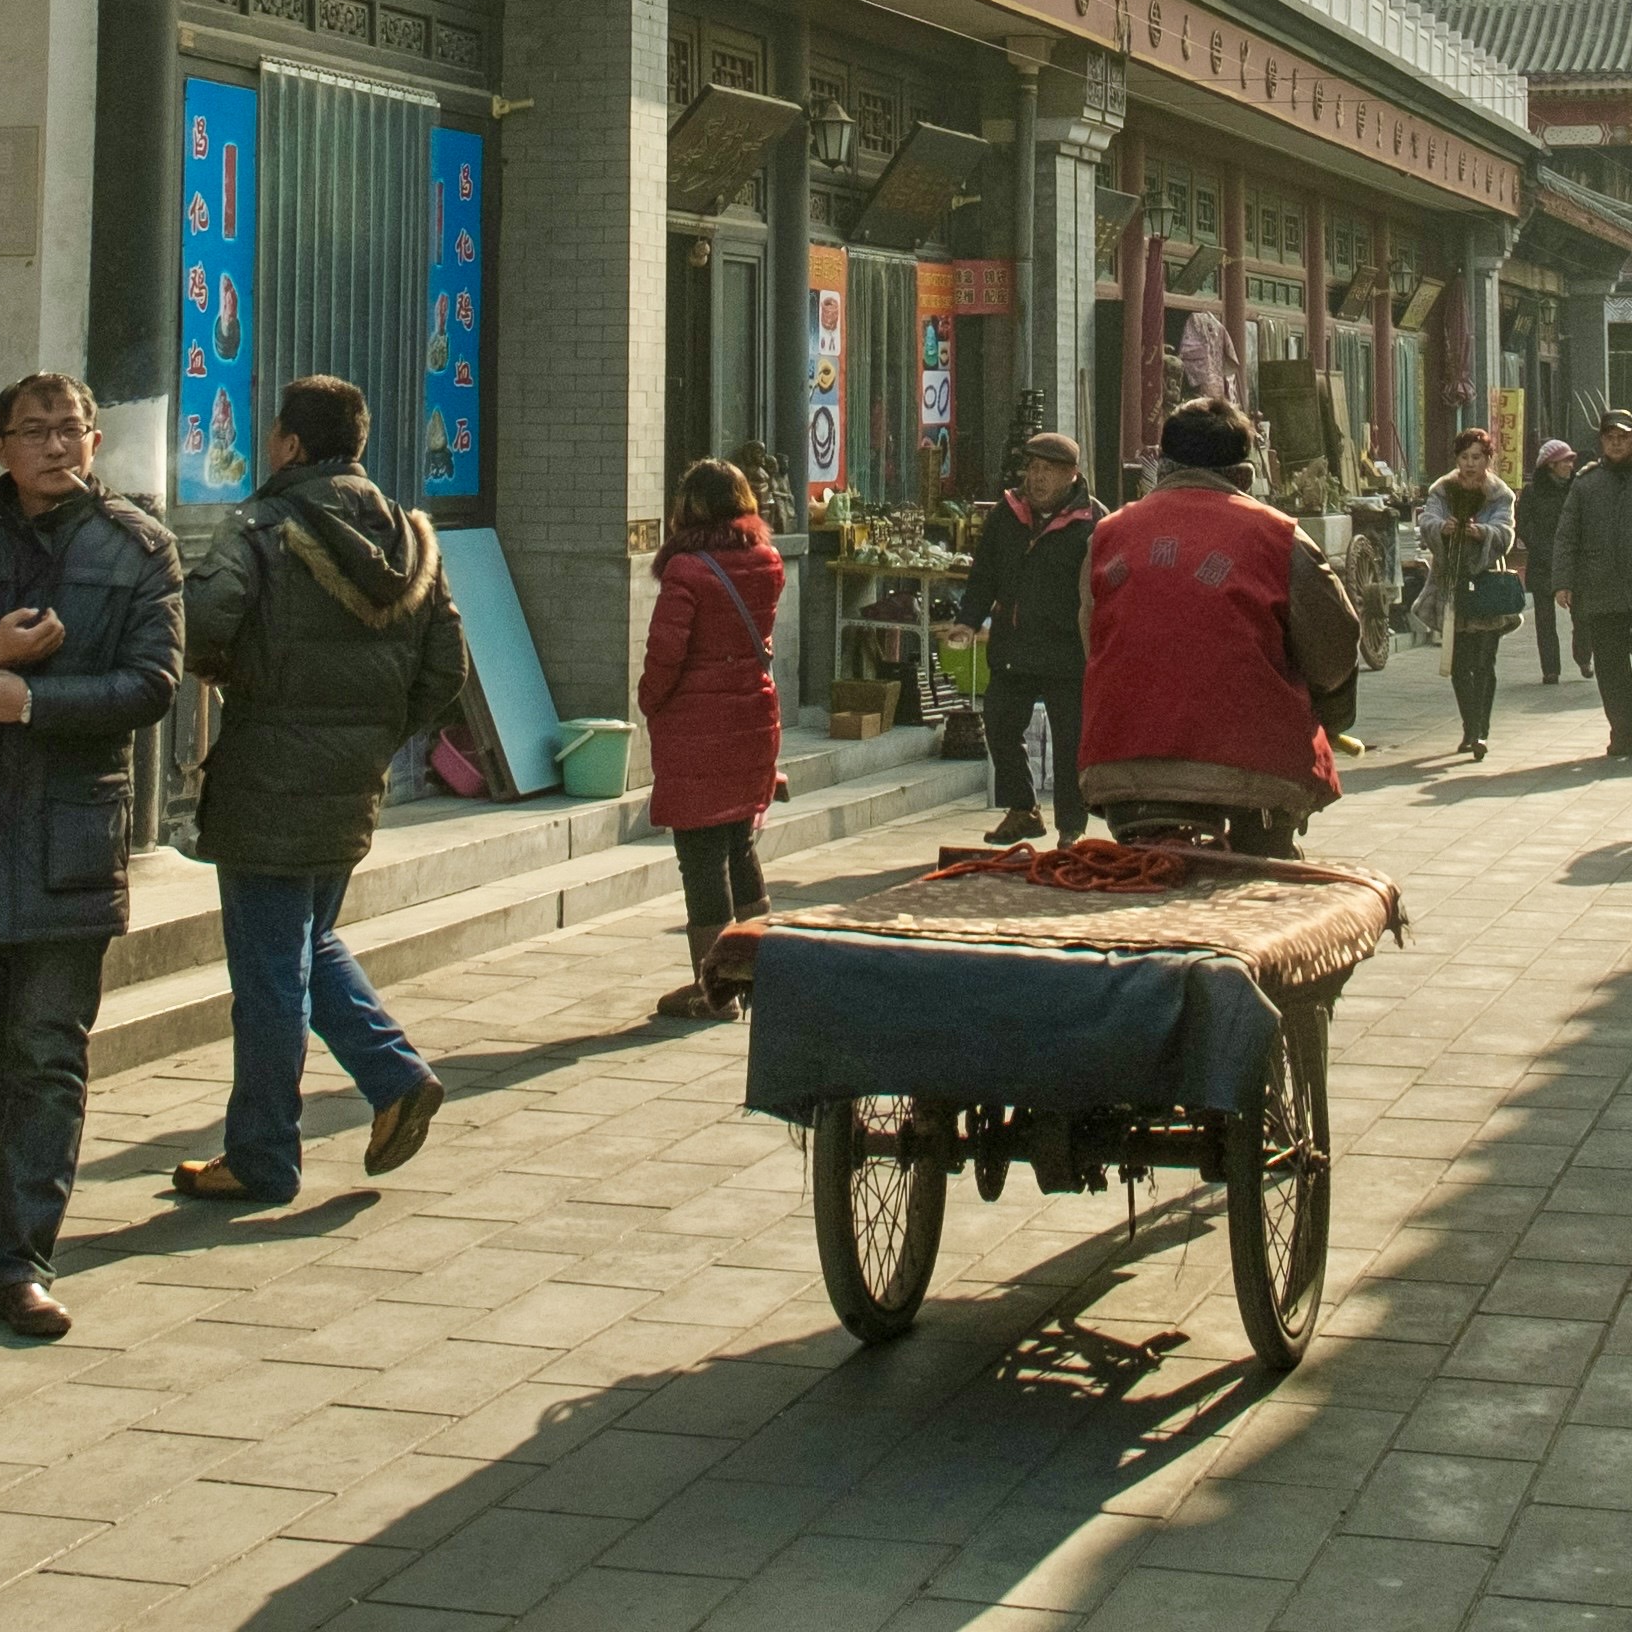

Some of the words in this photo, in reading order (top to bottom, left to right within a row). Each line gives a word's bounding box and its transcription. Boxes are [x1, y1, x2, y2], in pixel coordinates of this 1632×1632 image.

[183, 115, 209, 455] 昌化鸡血石
[452, 163, 475, 453] 昌化鸡血石
